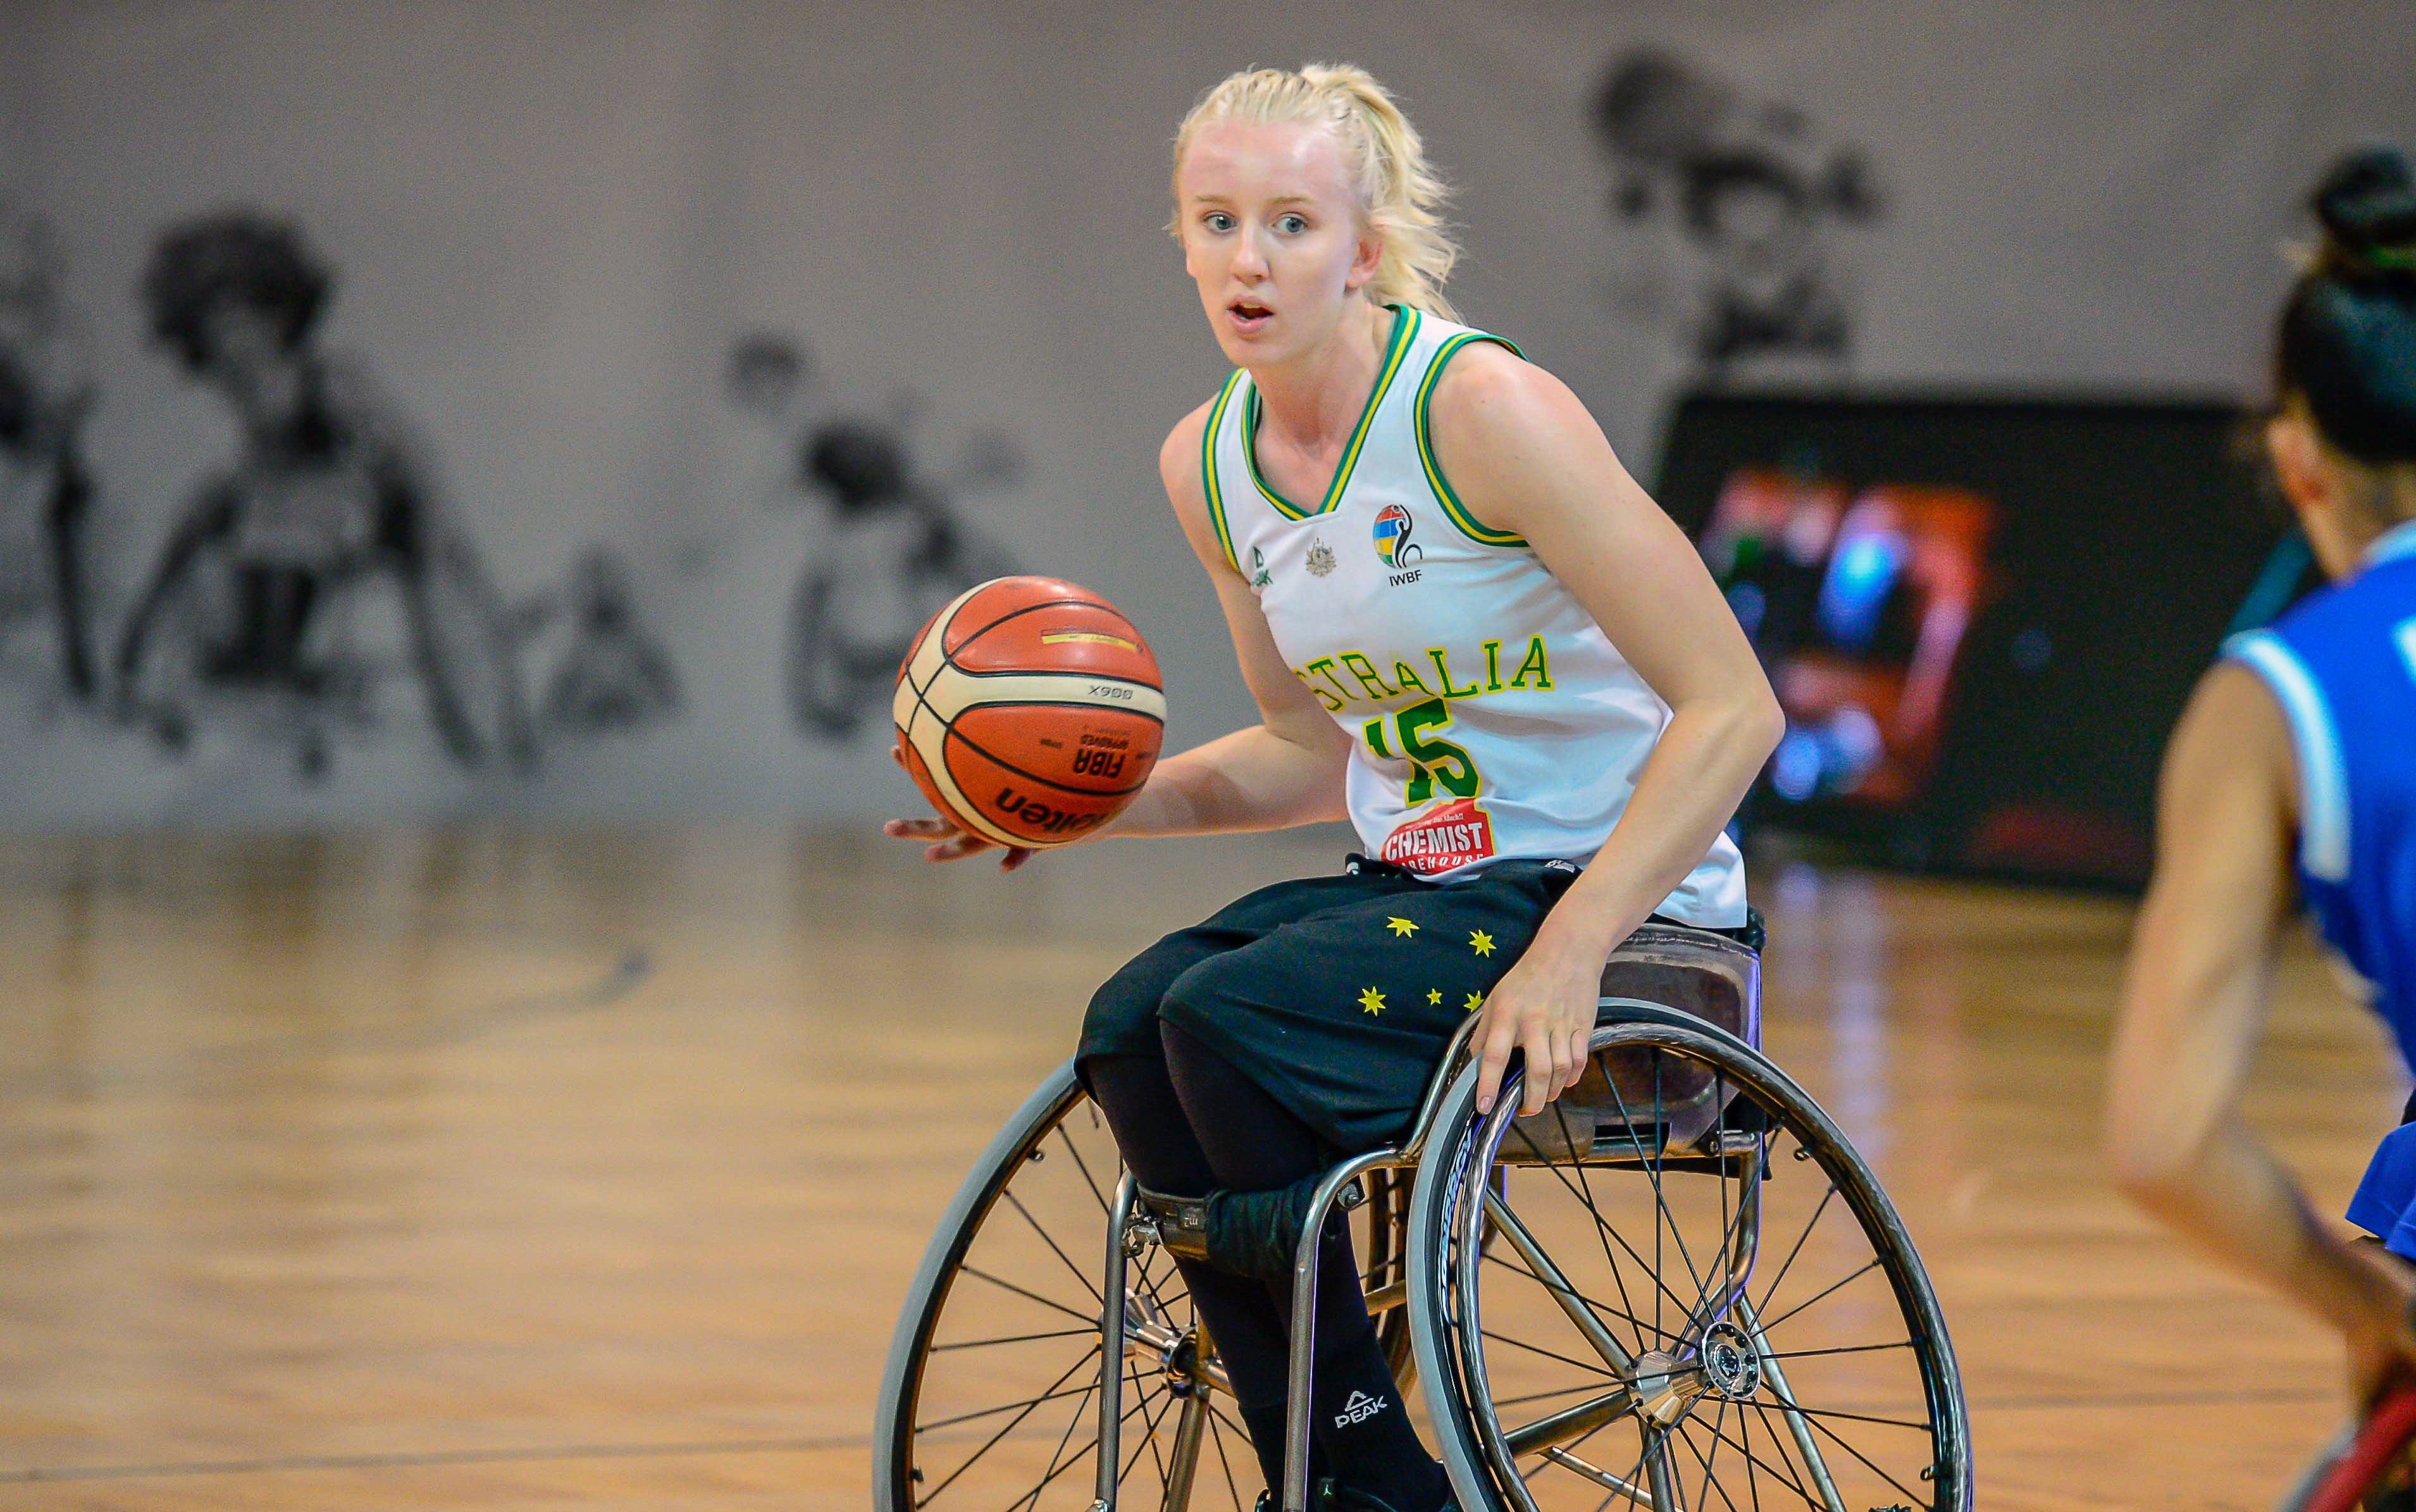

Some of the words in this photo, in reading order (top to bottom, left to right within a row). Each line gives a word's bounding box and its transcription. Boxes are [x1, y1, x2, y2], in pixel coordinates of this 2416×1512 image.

[1389, 569, 1423, 587] IWBF
[1073, 748, 1126, 778] FIBA
[1363, 695, 1483, 808] 15
[1385, 822, 1483, 861] CHEMIST
[1335, 1395, 1387, 1428] PEAK
